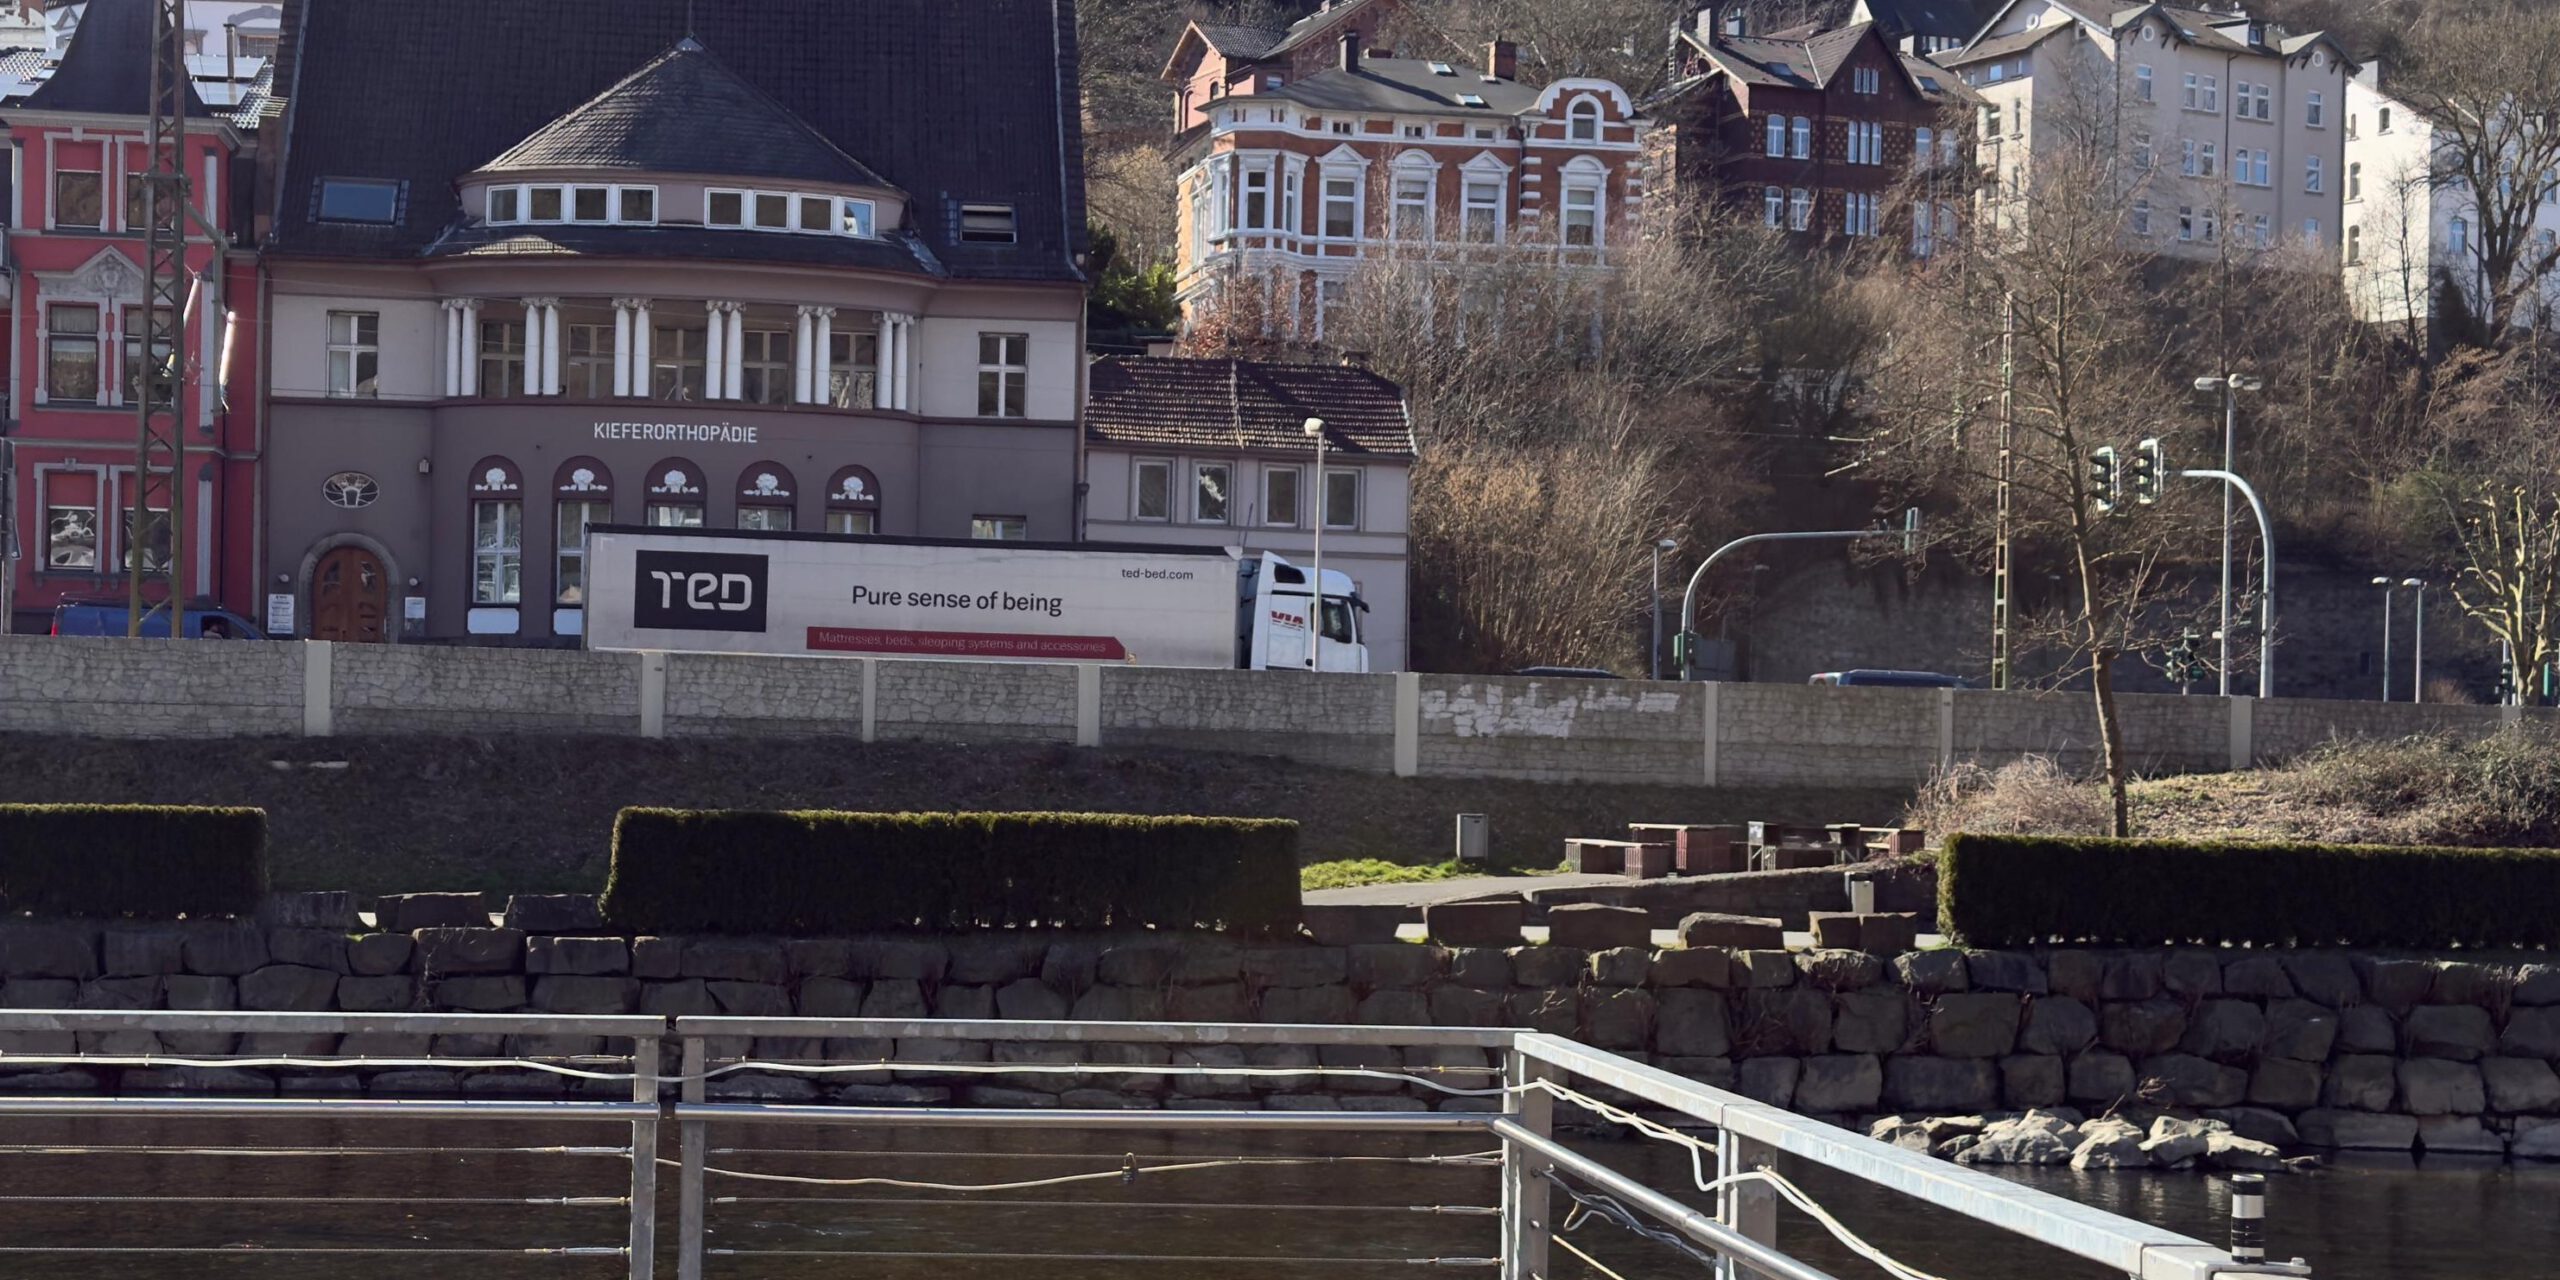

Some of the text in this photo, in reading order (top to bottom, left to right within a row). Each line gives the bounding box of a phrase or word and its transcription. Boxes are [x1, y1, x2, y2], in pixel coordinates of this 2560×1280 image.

[593, 422, 758, 443] KIEFERORTHOPÄDIE
[1121, 568, 1194, 580] ted-bed.com
[852, 585, 1062, 617] Pure sense of being
[818, 631, 882, 646] Mattresses,
[918, 636, 965, 650] sleeping
[966, 638, 1013, 651] systems
[1016, 639, 1038, 650] and
[1040, 641, 1106, 653] accessories
